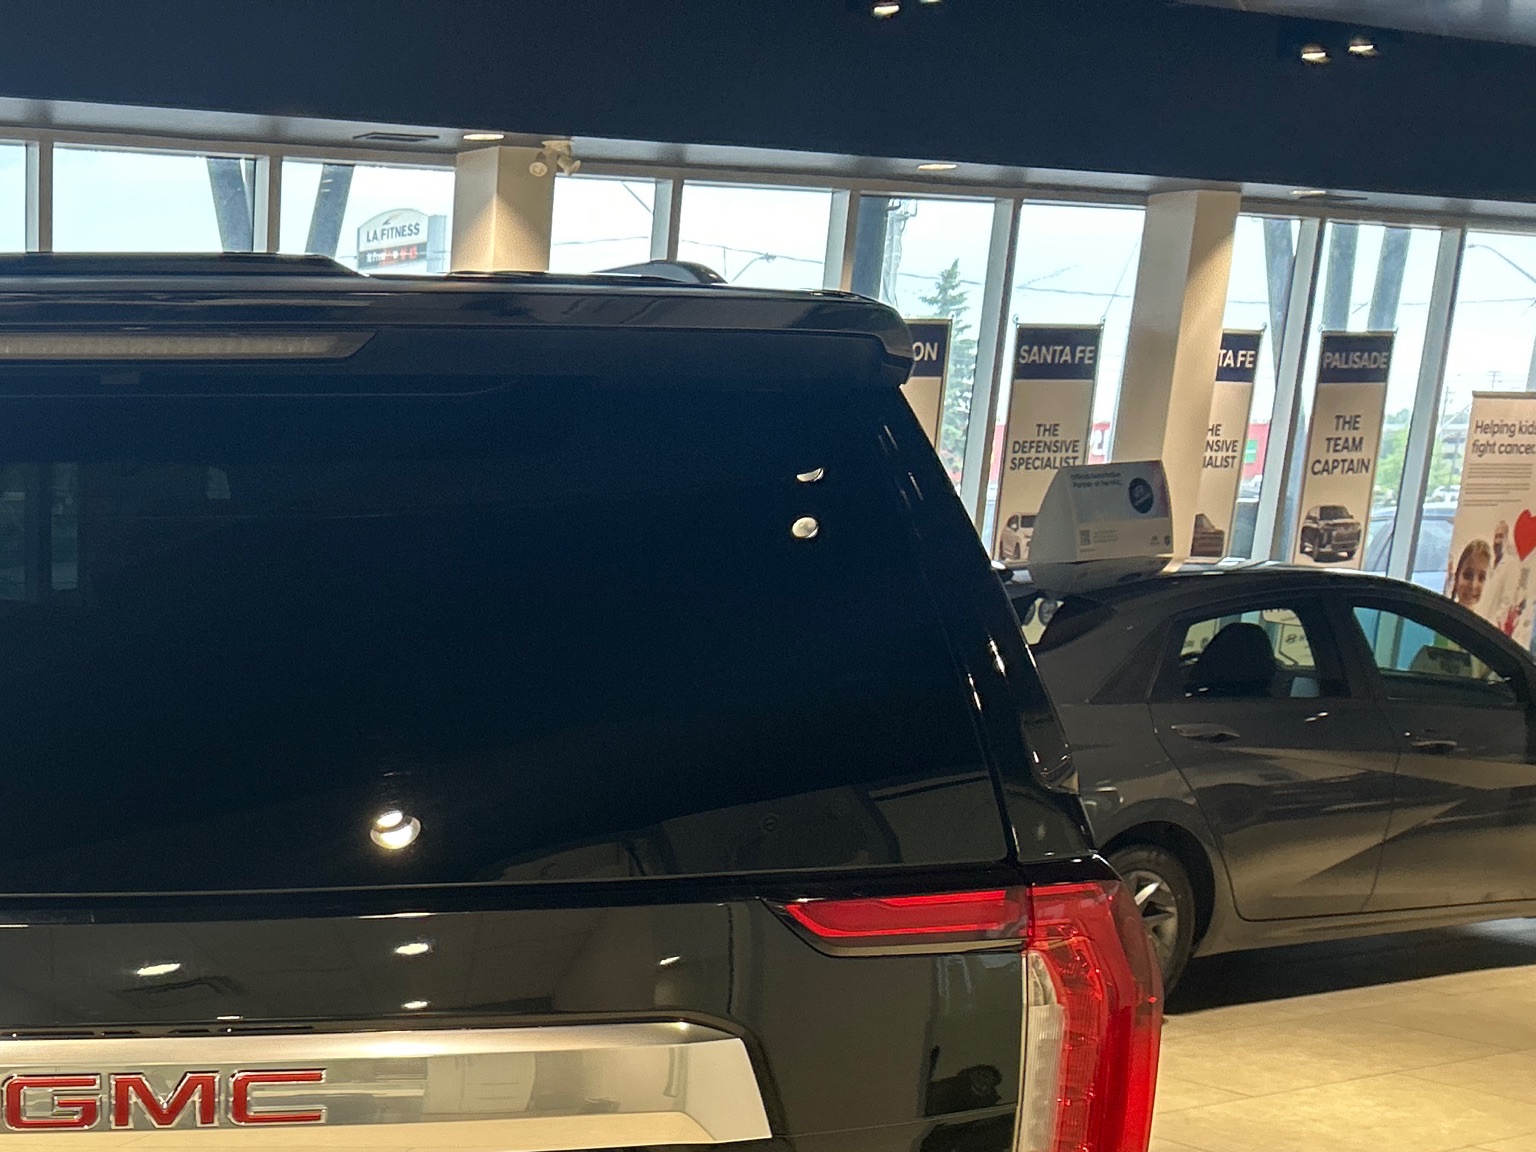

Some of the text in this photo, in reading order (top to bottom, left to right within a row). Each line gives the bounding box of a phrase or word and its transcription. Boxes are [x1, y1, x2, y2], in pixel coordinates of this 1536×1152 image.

[366, 222, 421, 243] LA FITNESS
[1018, 345, 1095, 364] SANTA FE
[1235, 350, 1256, 368] FE
[1323, 351, 1388, 369] PALISADE
[1035, 423, 1060, 437] THE
[1207, 423, 1222, 437] HE
[1334, 415, 1361, 431] THE
[1474, 419, 1536, 438] Helping kid
[1012, 440, 1080, 454] DEFENSIVE
[1205, 439, 1239, 453] NSIVE
[1325, 437, 1364, 453] TEAM
[1471, 439, 1497, 457] fight
[1010, 456, 1079, 471] SPECIALIST
[1203, 455, 1237, 468] IALIST
[1311, 459, 1371, 476] CAPTAIN
[2, 1068, 327, 1131] GMC
